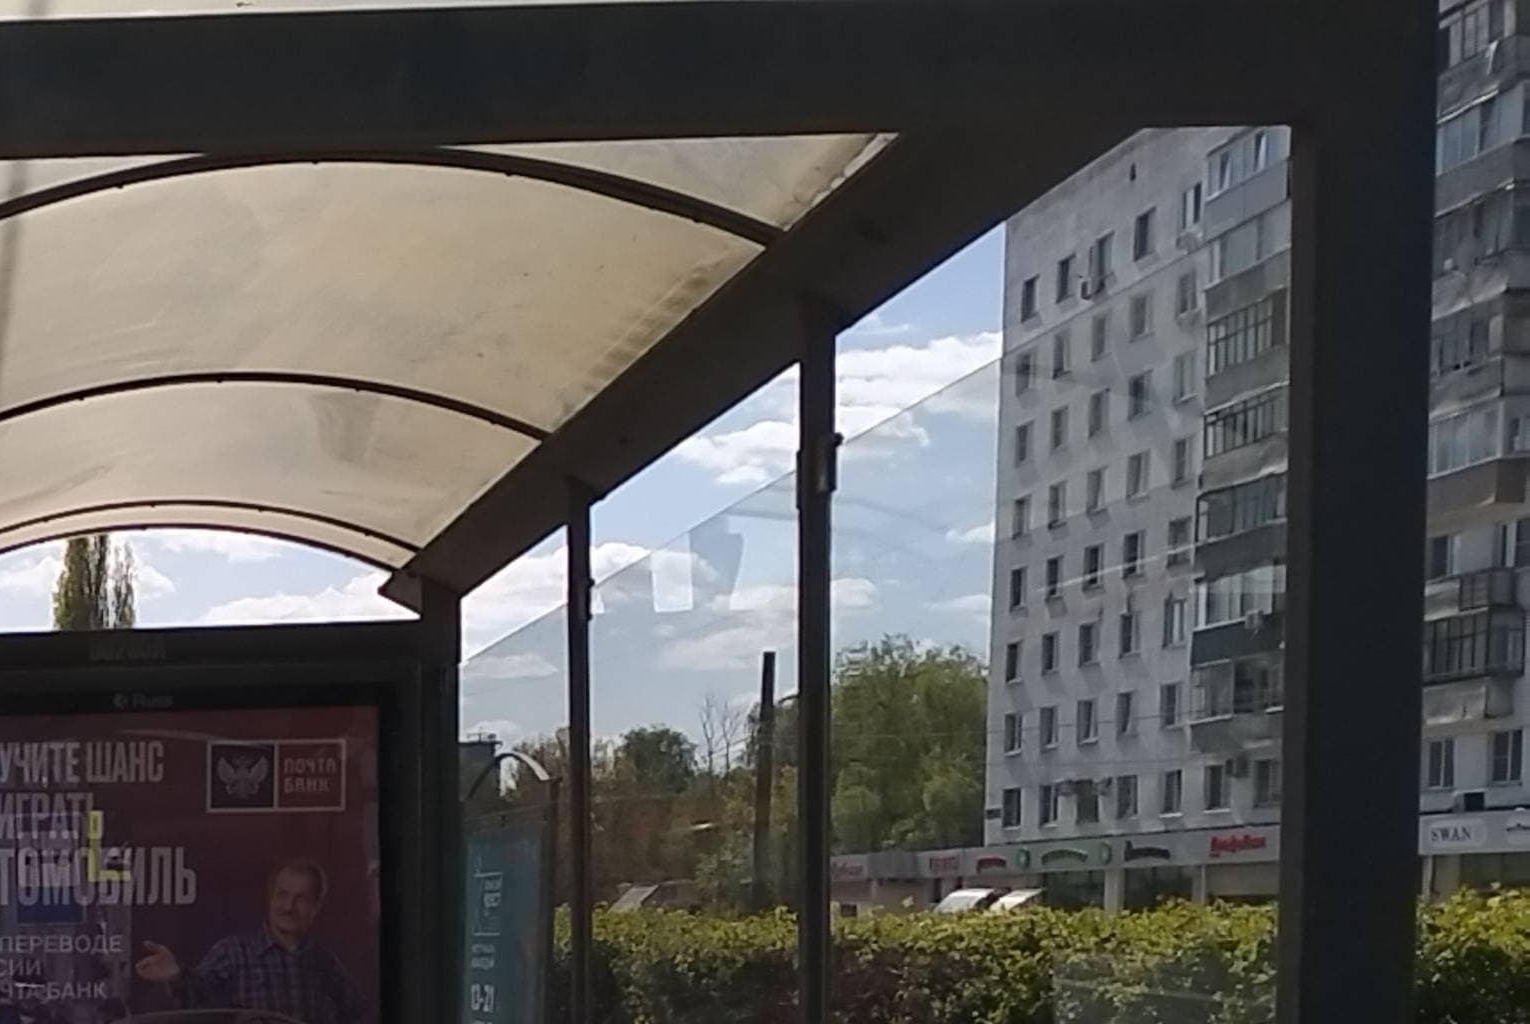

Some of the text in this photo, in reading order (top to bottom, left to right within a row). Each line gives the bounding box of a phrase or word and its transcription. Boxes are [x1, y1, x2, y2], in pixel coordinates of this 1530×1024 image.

[86, 741, 165, 783] ШАНС
[283, 758, 337, 774] ПОЧТА
[283, 777, 330, 793] БАНК
[1430, 825, 1472, 841] SWAN
[0, 935, 124, 954] ПЕРЕВОДЕ
[46, 982, 108, 1000] БАНК
